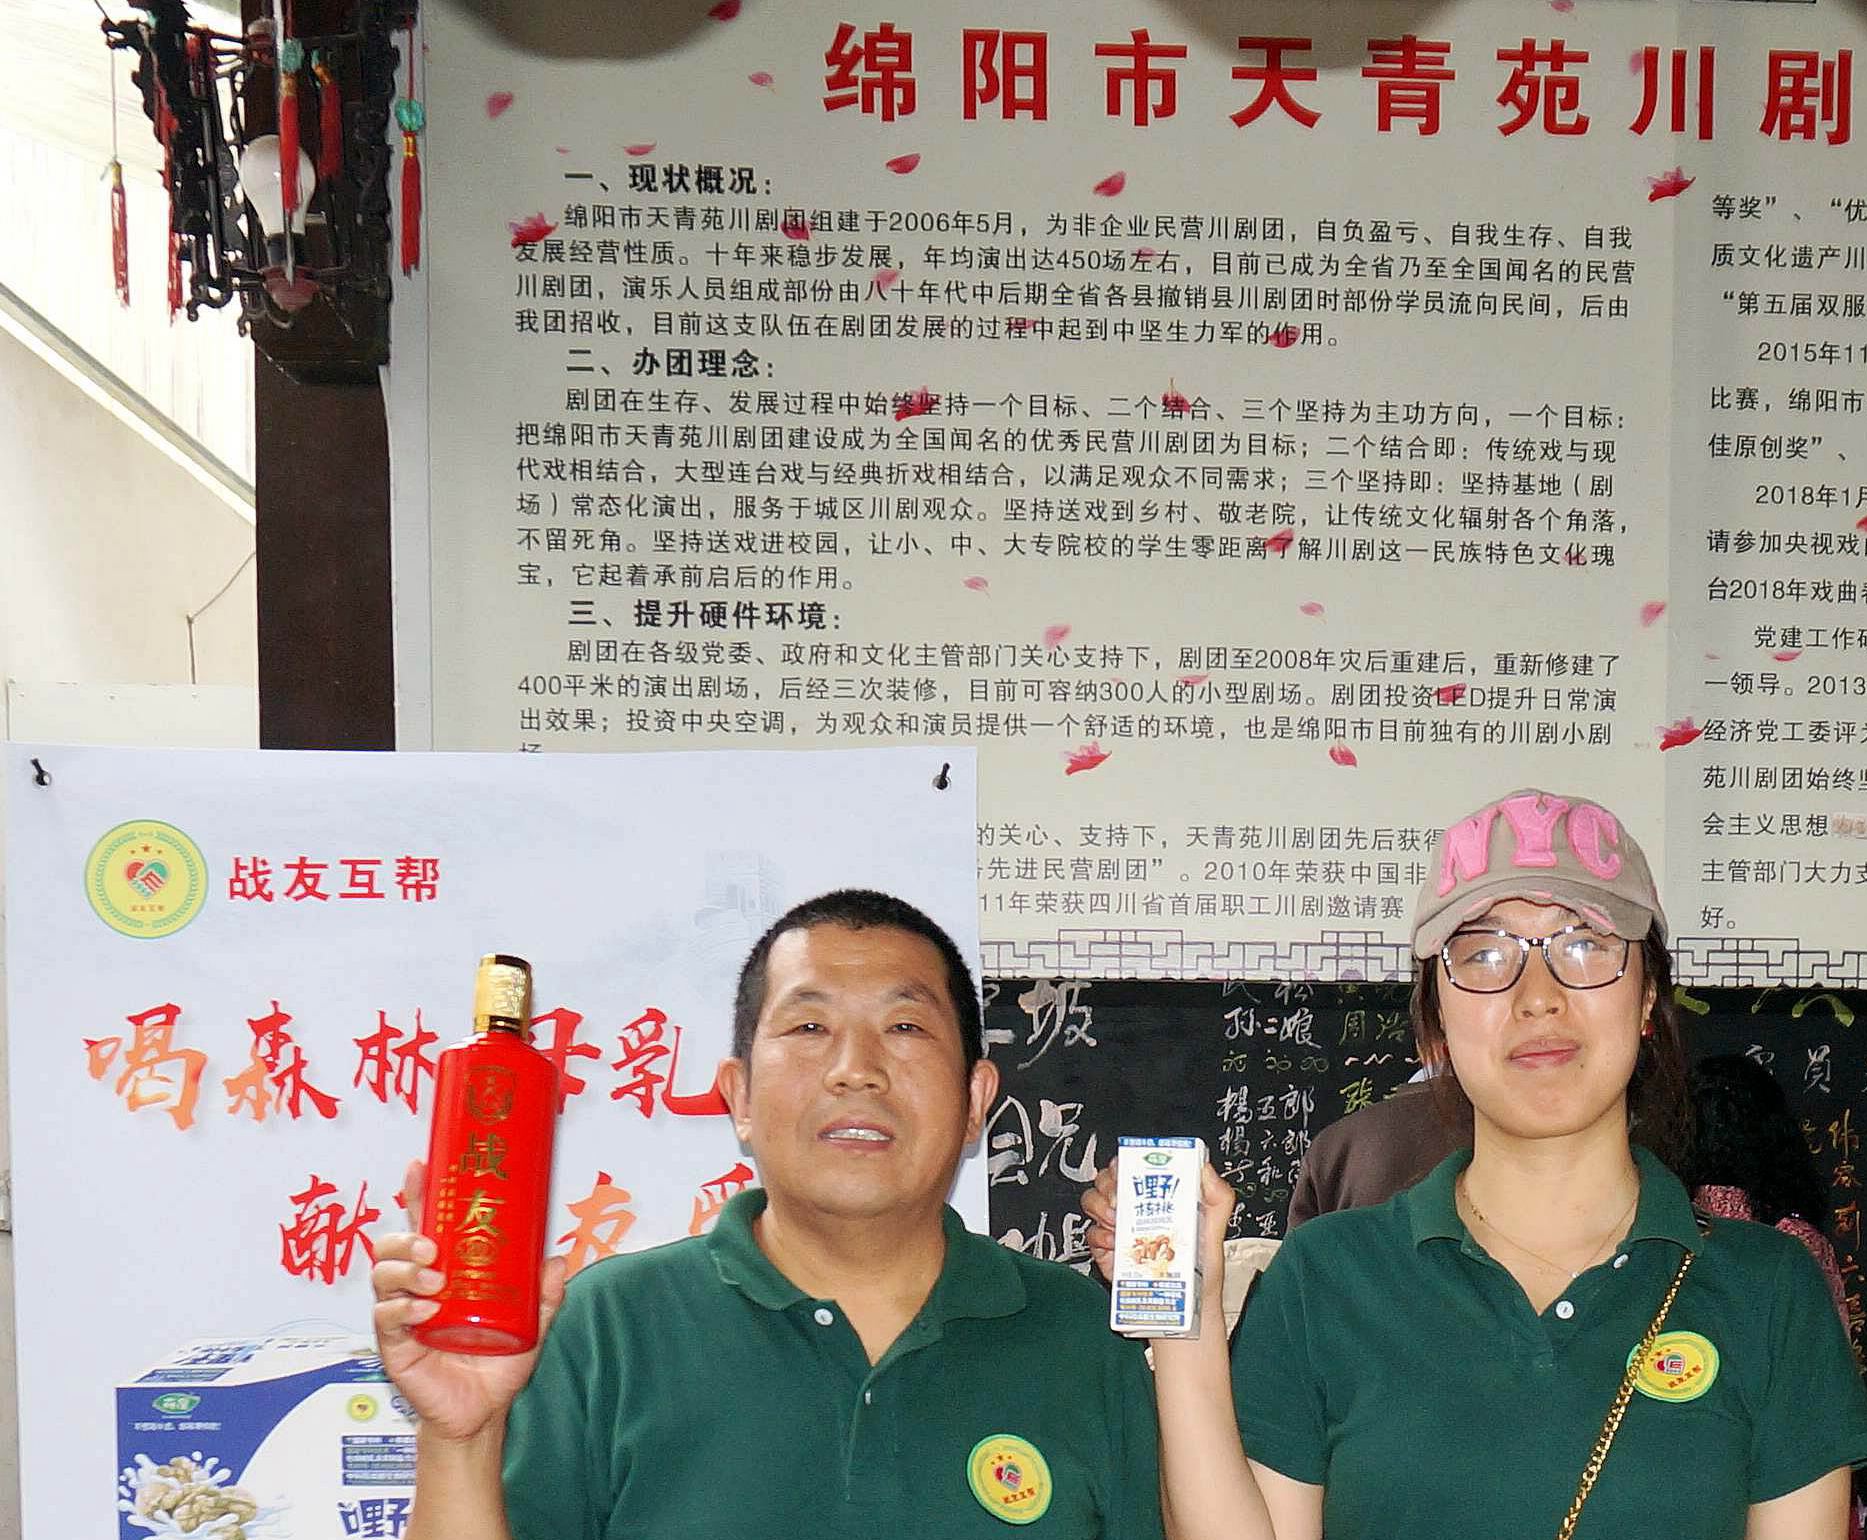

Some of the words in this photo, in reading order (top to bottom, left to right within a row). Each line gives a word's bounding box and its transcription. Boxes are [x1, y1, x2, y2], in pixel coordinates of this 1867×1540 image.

[565, 164, 772, 196] 一、现状概况：
[565, 347, 775, 379] 二、办团理念：
[568, 600, 842, 632] 三、提升硬件环境：
[1439, 790, 1621, 897] NYC
[229, 855, 441, 902] 战友互帮
[977, 856, 1427, 886] 先进民营剧团”。2010年荣获中国非
